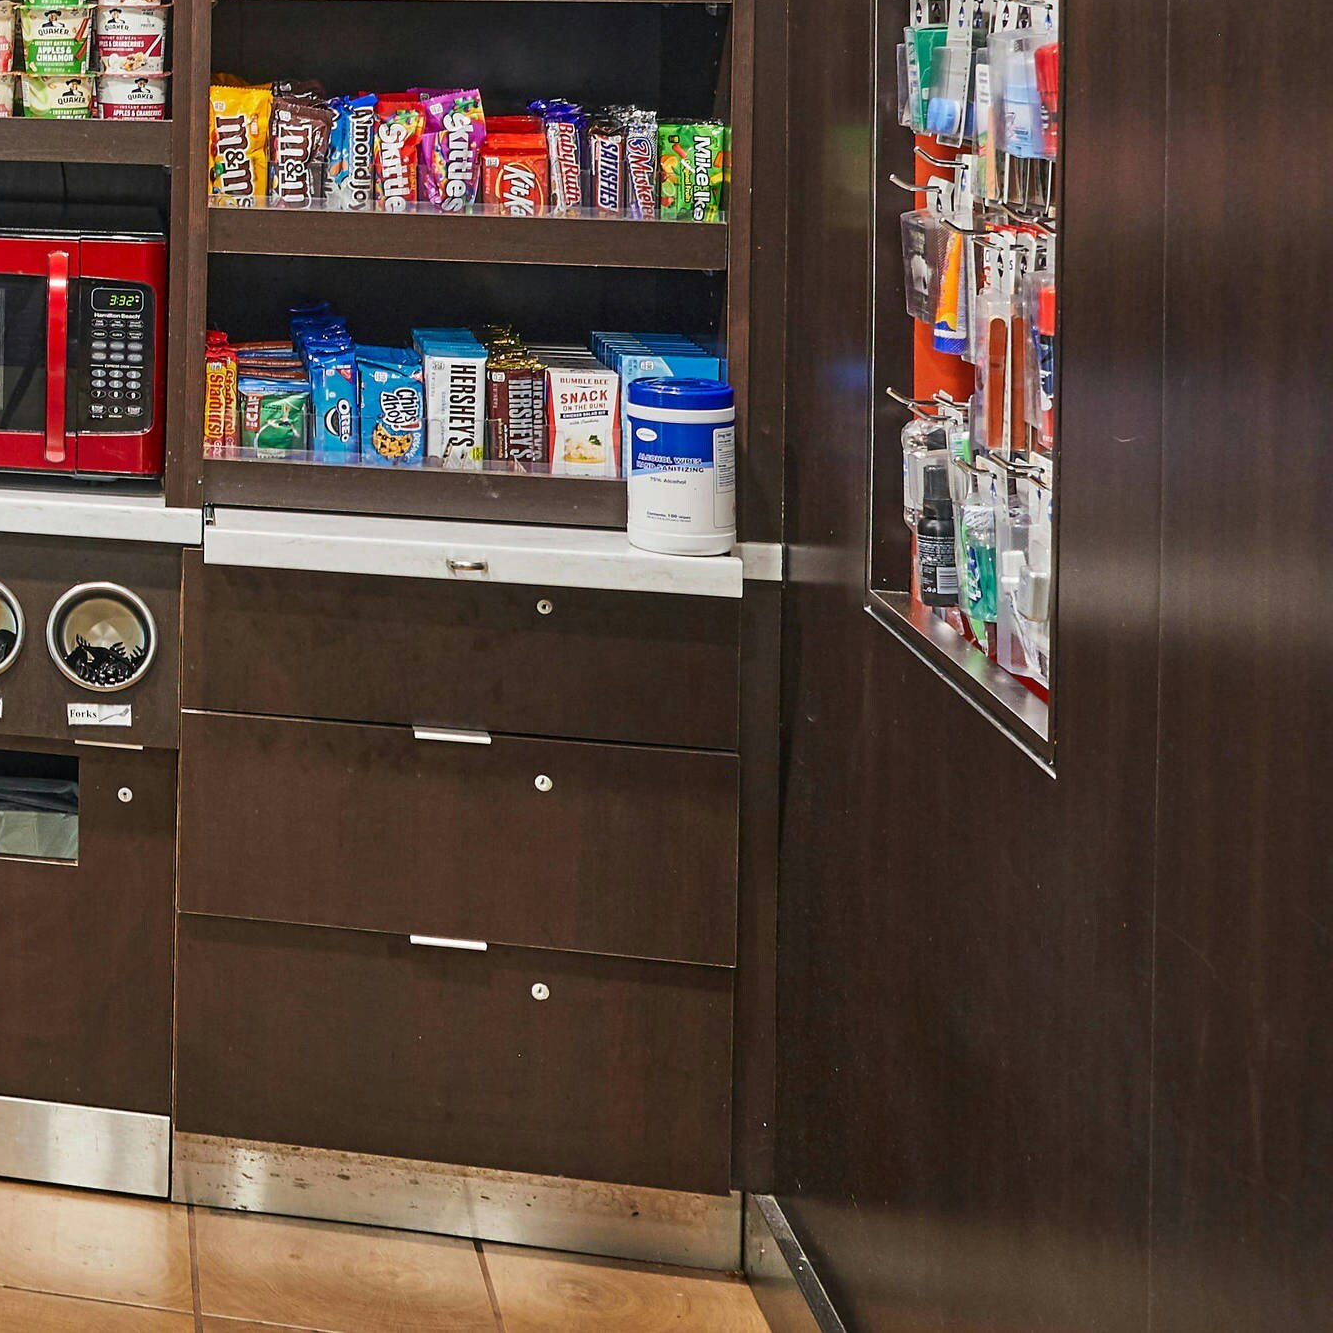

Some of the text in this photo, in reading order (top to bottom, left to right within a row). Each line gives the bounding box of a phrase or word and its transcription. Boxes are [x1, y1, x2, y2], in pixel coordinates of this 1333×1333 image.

[37, 27, 69, 36] QUAKER
[104, 23, 130, 31] QUAKER
[37, 46, 71, 54] APPLES &
[36, 54, 74, 62] CINNAMON
[57, 97, 87, 105] QUAKER
[127, 92, 154, 101] QUAKER
[628, 138, 651, 156] 3
[278, 123, 313, 209] m&m
[378, 122, 410, 213] Skittle
[441, 112, 474, 213] Skittles
[599, 139, 619, 212] SATISFIES
[693, 136, 711, 221] Mike Ike
[109, 294, 135, 307] 3:32
[560, 377, 591, 385] BUMBLE
[560, 389, 609, 404] SNACK
[246, 396, 260, 421] CLIF
[395, 388, 418, 423] Chips
[448, 364, 477, 448] HERSHEY'S
[336, 399, 351, 443] OREO
[508, 379, 533, 459] HERSHEY'S
[637, 452, 702, 465] ALCOHOL WIPES
[656, 463, 704, 473] SANITIZING
[69, 708, 97, 720] Forks
